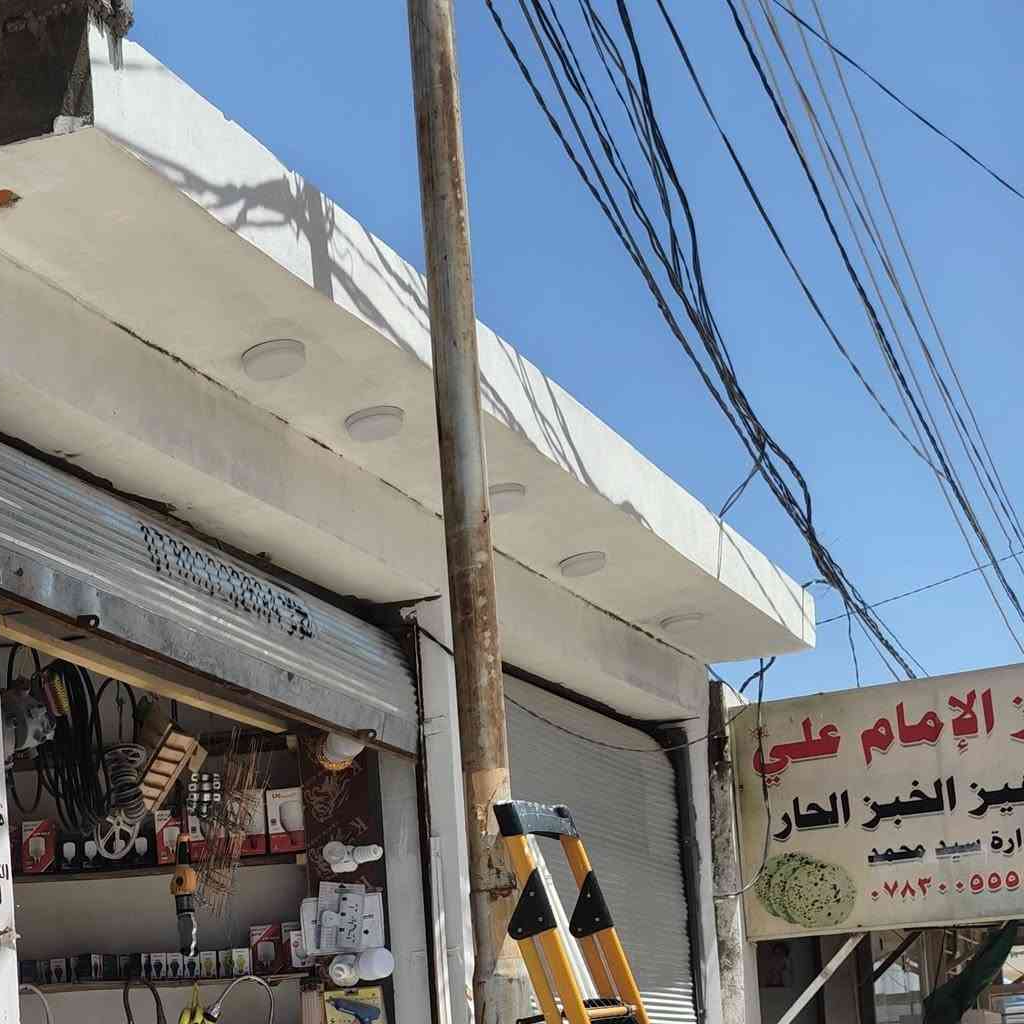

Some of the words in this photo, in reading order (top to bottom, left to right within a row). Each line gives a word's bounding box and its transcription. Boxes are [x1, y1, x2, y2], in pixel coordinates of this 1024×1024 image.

[752, 716, 841, 786] علي
[860, 687, 995, 767] الإمام
[772, 789, 850, 842] الحار
[861, 775, 957, 830] الخبز
[867, 842, 926, 866] محمد
[935, 838, 982, 862] سيد
